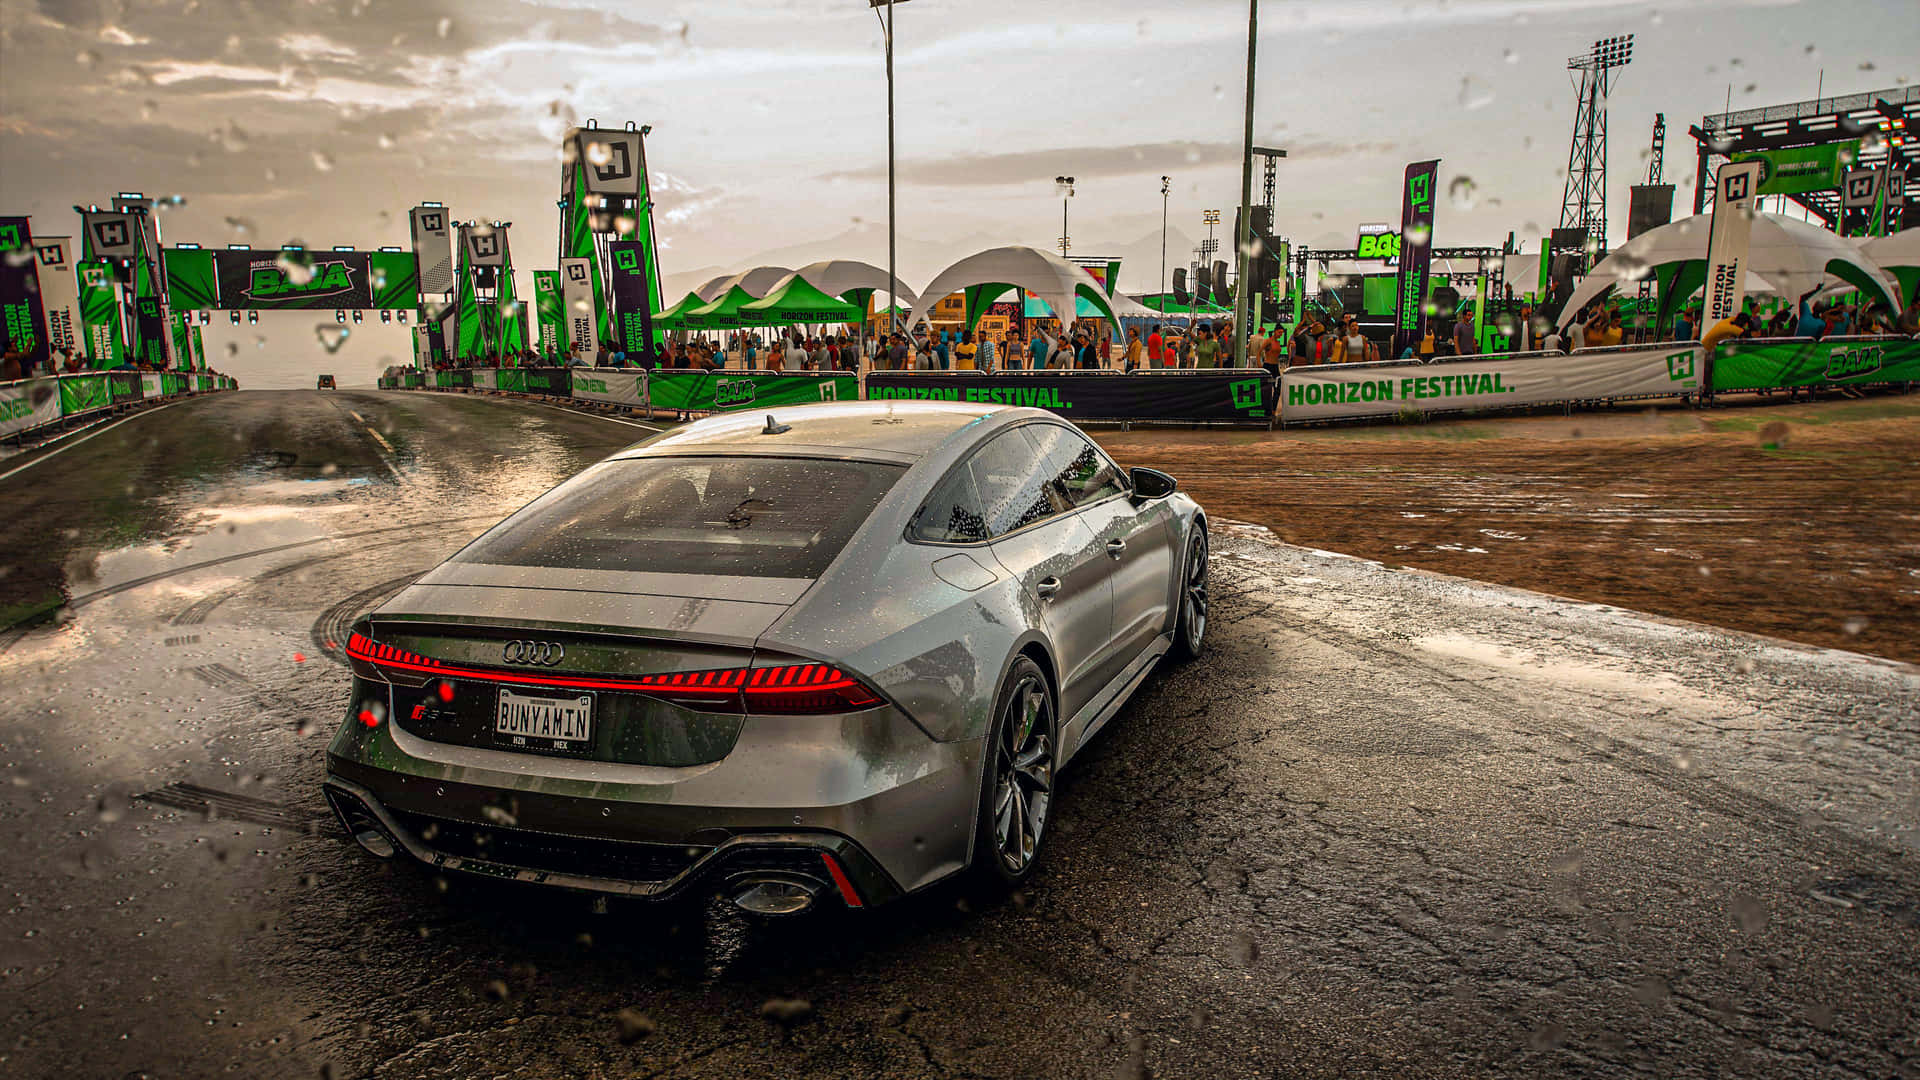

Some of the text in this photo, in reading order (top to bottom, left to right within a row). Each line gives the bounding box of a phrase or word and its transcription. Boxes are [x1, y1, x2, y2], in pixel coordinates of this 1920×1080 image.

[251, 260, 283, 268] HORIZO
[1711, 264, 1727, 320] HORIZON
[1722, 257, 1738, 320] FESTIVAL.
[633, 307, 644, 352] FESTIVAL.
[781, 311, 814, 320] HORIZON
[624, 312, 635, 352] HORIZON
[1828, 346, 1880, 377] BAJA
[716, 380, 753, 403] BAJA
[868, 387, 1073, 409] HORIZON FESTIVAL.
[1288, 373, 1516, 406] HORIZON FESTIVAL.
[500, 702, 587, 738] BUNYAMIN
[513, 736, 568, 750] HZN MEX
